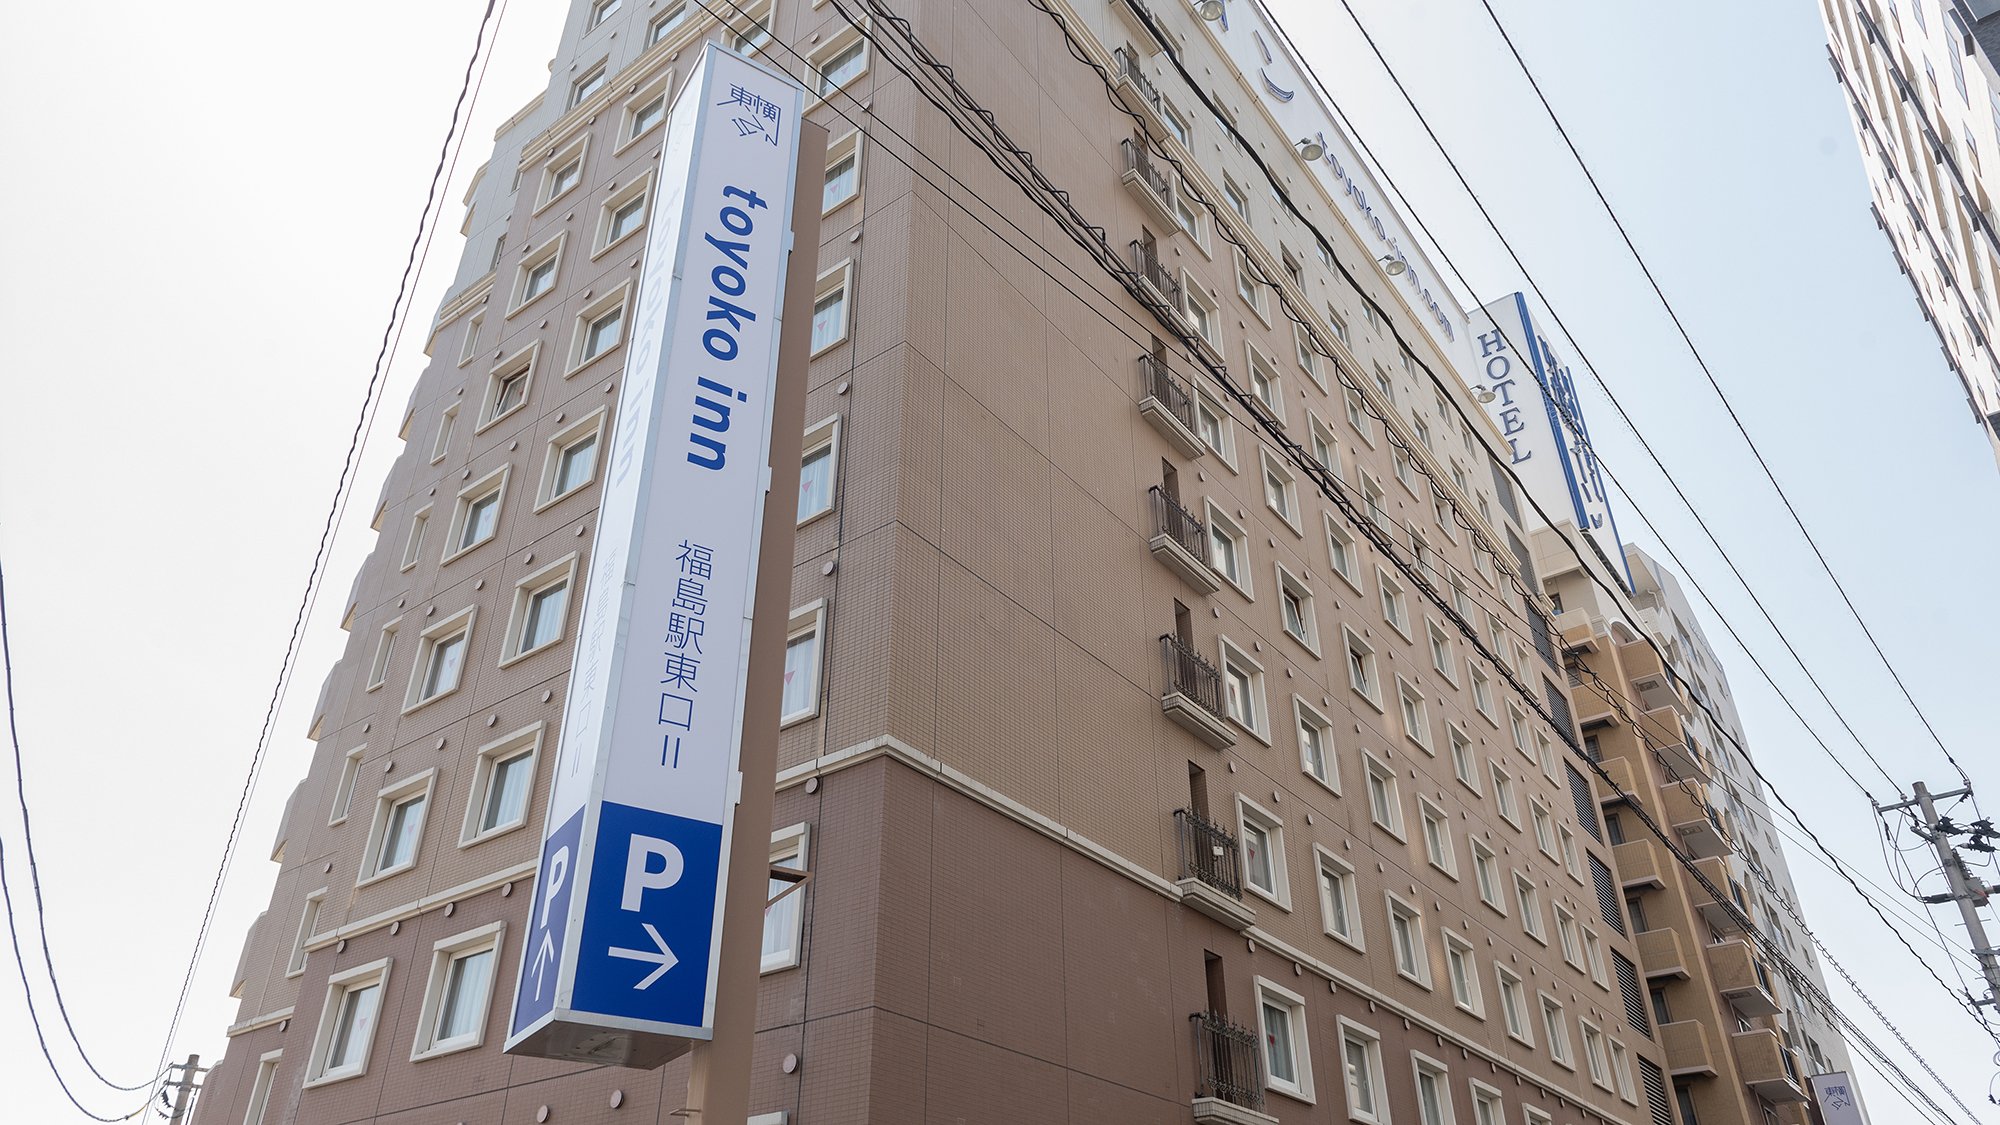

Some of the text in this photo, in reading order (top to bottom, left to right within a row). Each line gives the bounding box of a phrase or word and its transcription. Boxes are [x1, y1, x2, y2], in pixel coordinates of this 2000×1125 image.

[615, 186, 681, 489] toyoko inn
[687, 185, 768, 471] toyoko inn
[1477, 327, 1532, 465] HOTEL
[540, 845, 570, 929] P
[621, 833, 684, 912] P
